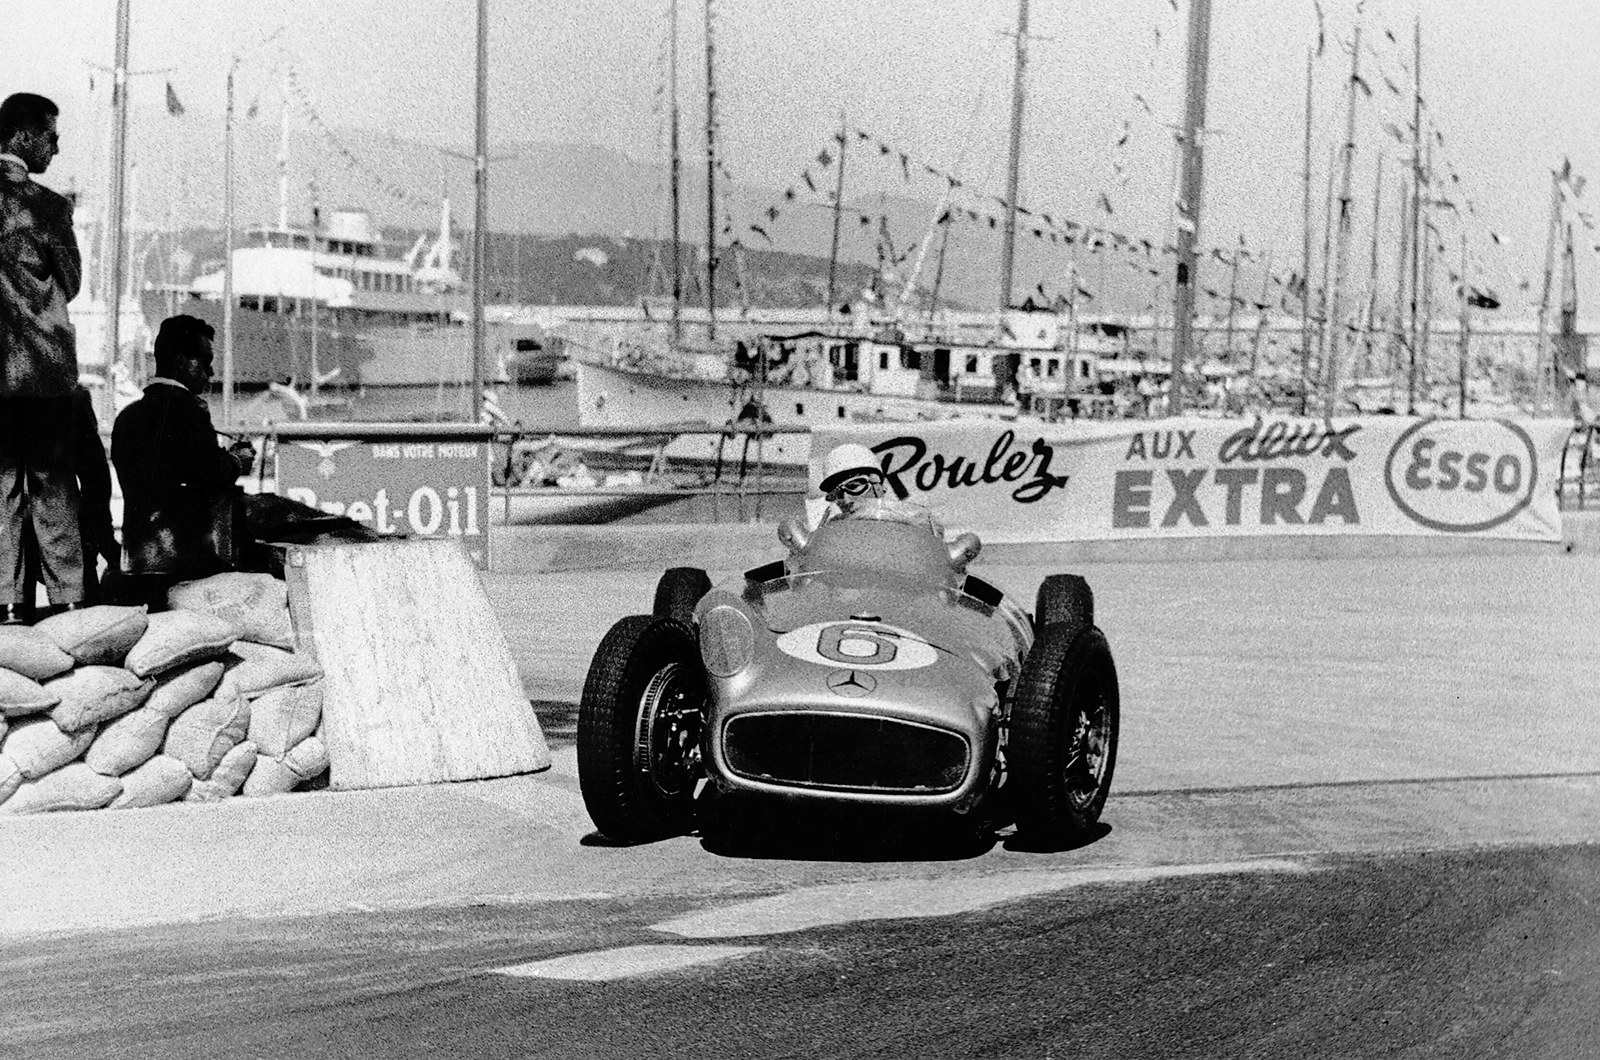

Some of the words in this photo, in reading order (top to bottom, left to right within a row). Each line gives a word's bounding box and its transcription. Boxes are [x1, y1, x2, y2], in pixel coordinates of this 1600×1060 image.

[1126, 431, 1197, 460] AUX
[1218, 415, 1362, 463] deux
[871, 430, 1069, 503] Roulez
[1112, 467, 1361, 528] EXTRA
[816, 622, 898, 666] 6
